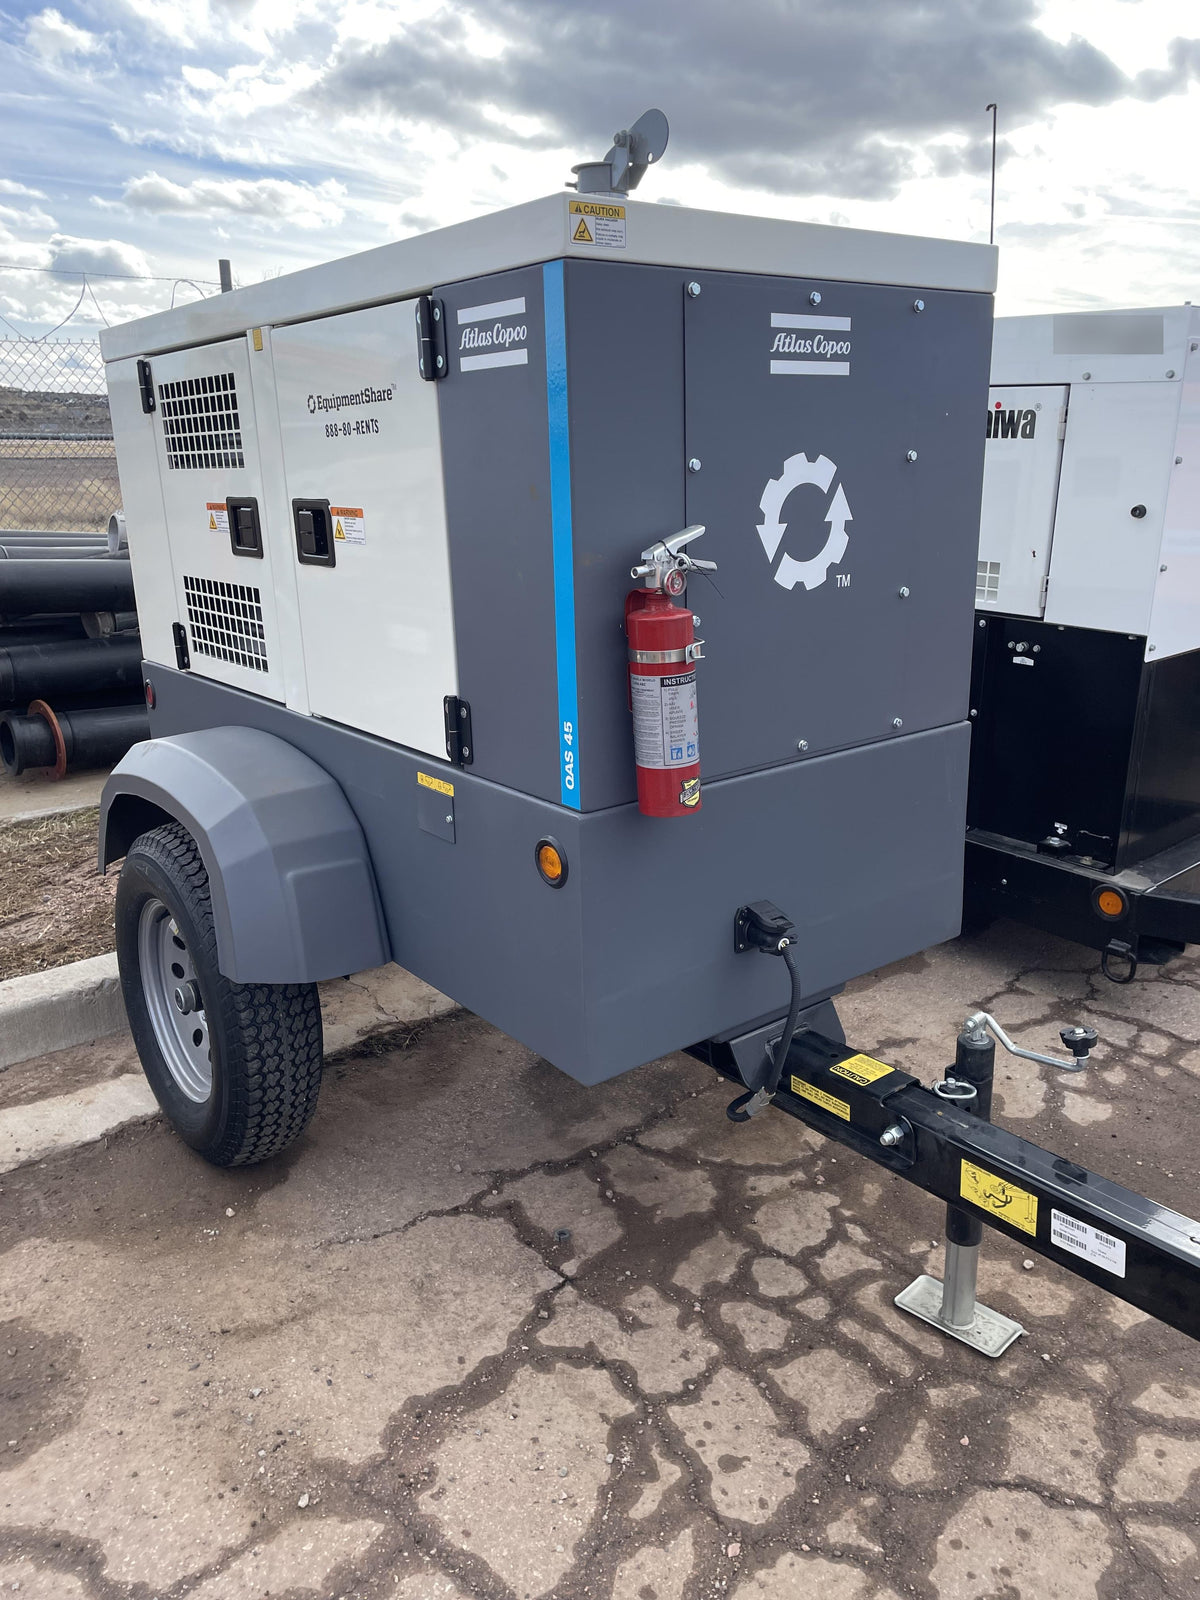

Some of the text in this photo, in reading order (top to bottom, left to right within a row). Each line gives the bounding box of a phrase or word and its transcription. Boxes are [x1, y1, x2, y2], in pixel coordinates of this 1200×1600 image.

[583, 204, 620, 217] CAUTION
[459, 323, 527, 350] Atlas Copco
[769, 332, 851, 358] Atlas Copco
[316, 387, 393, 413] EquipmentShare
[325, 418, 380, 438] 888-80-RENTS
[835, 573, 851, 588] TM
[563, 721, 575, 790] QAS 45
[833, 1065, 868, 1084] CAUTION
